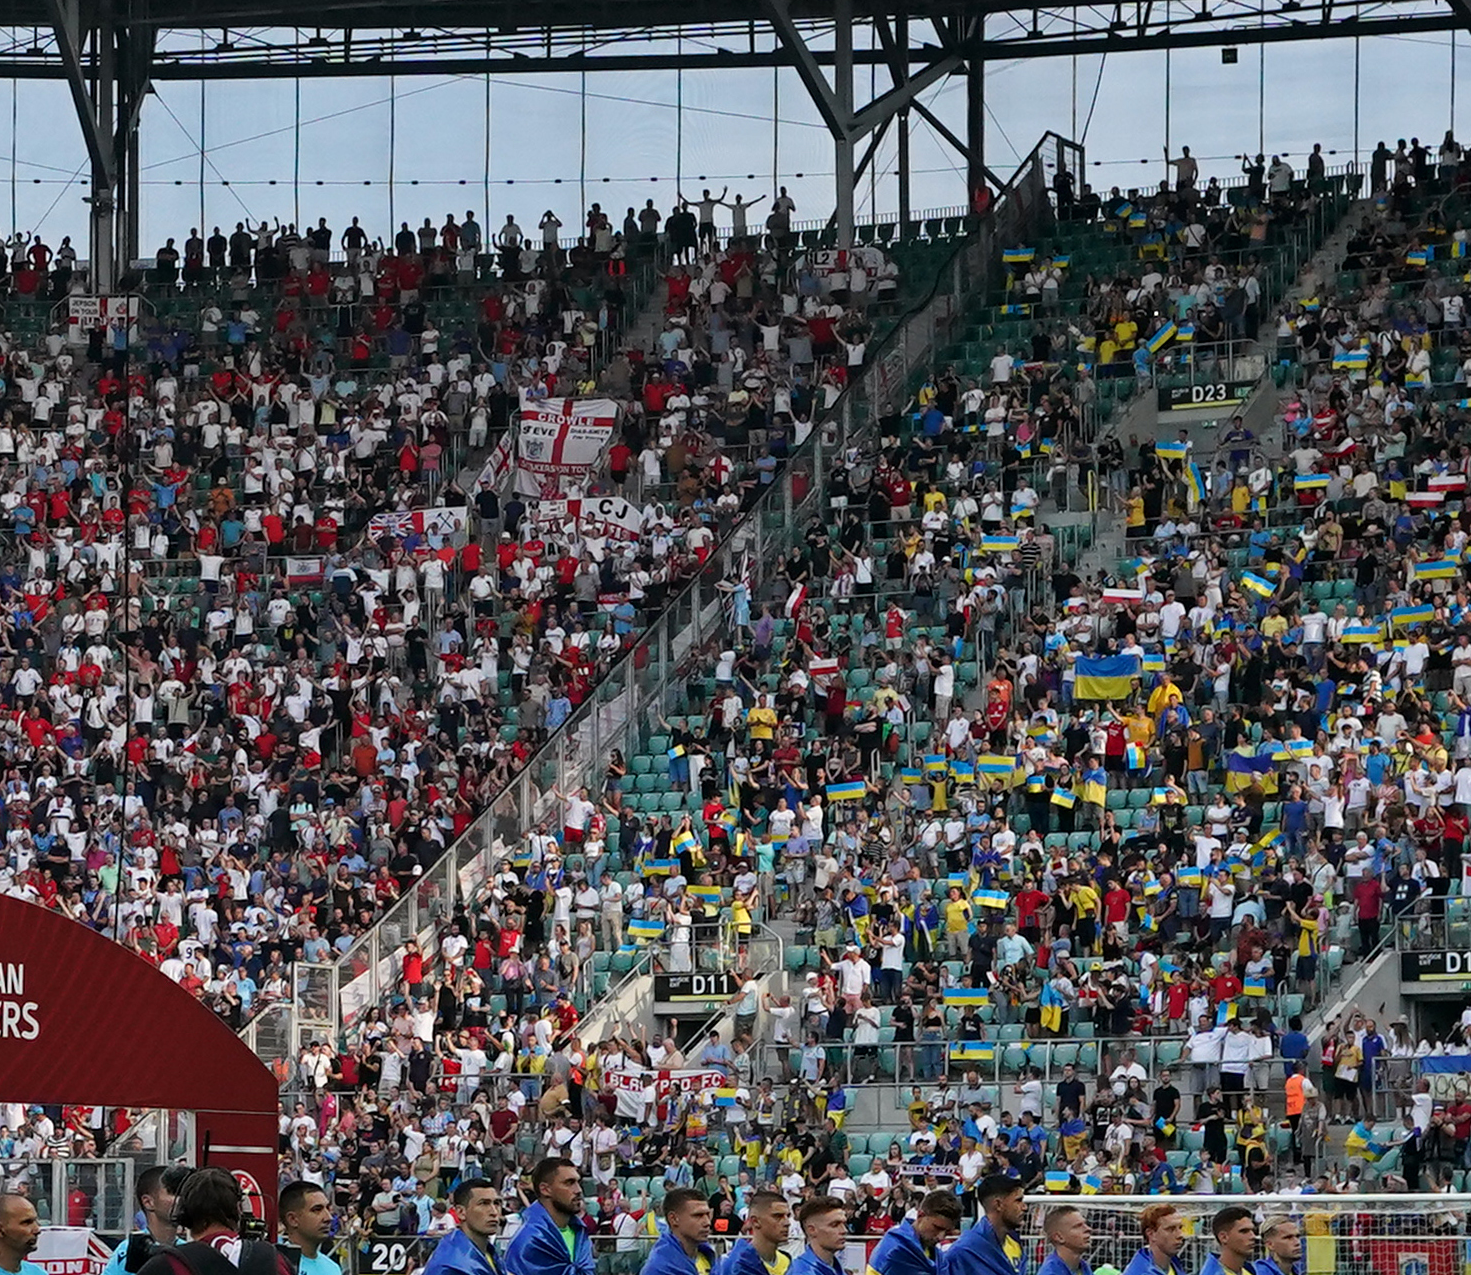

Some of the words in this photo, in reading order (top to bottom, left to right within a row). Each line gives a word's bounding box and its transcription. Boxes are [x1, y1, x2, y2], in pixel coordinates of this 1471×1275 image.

[1192, 384, 1227, 403] D23
[537, 412, 595, 426] CROWLE
[692, 974, 729, 995] D11
[371, 1243, 407, 1271] 20
